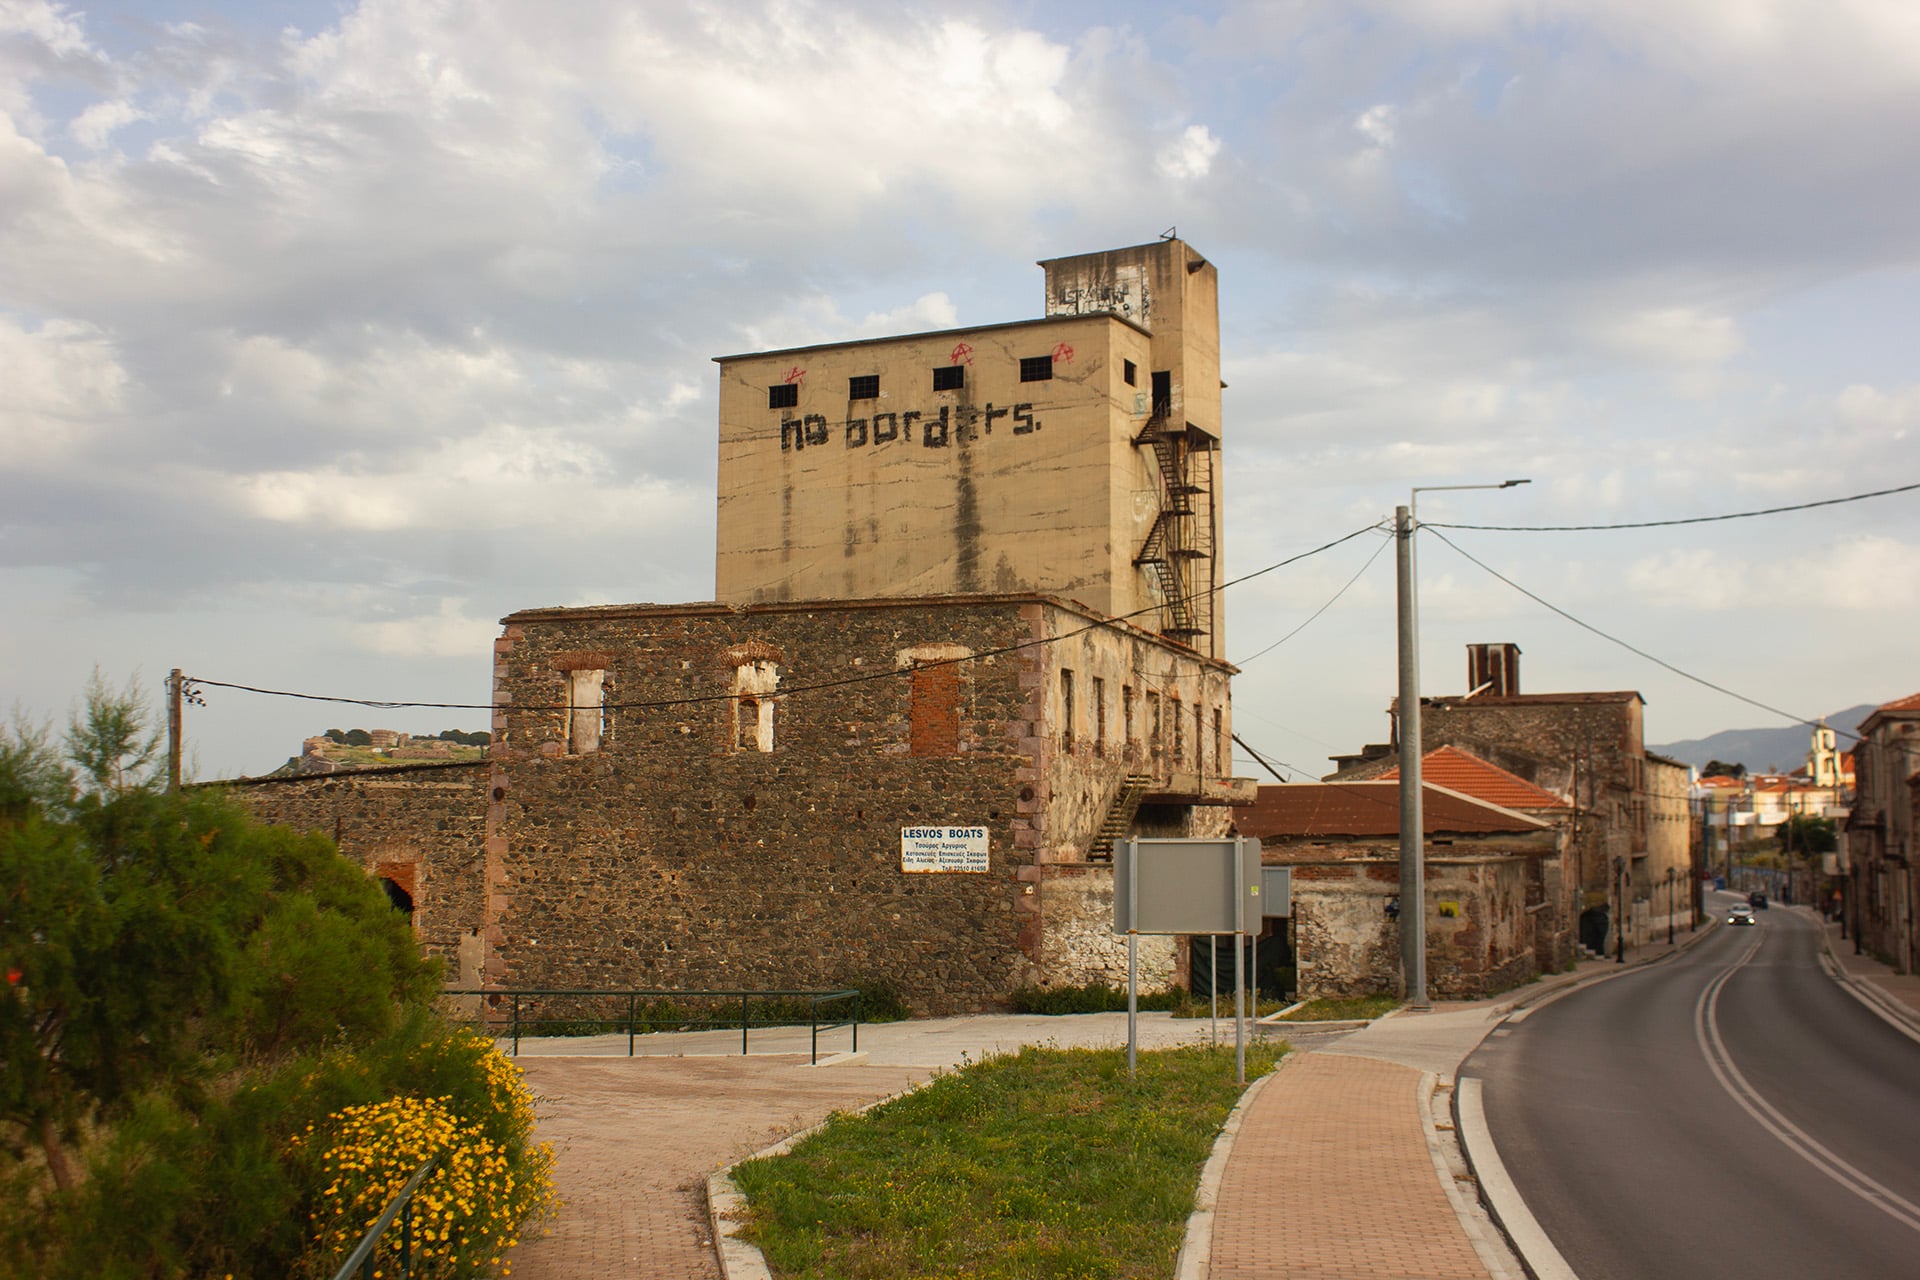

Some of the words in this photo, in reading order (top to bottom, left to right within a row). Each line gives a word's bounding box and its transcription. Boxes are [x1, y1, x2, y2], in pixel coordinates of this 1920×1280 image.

[781, 413, 829, 450] no
[903, 829, 943, 839] LESVOS
[949, 829, 984, 839] BOATS
